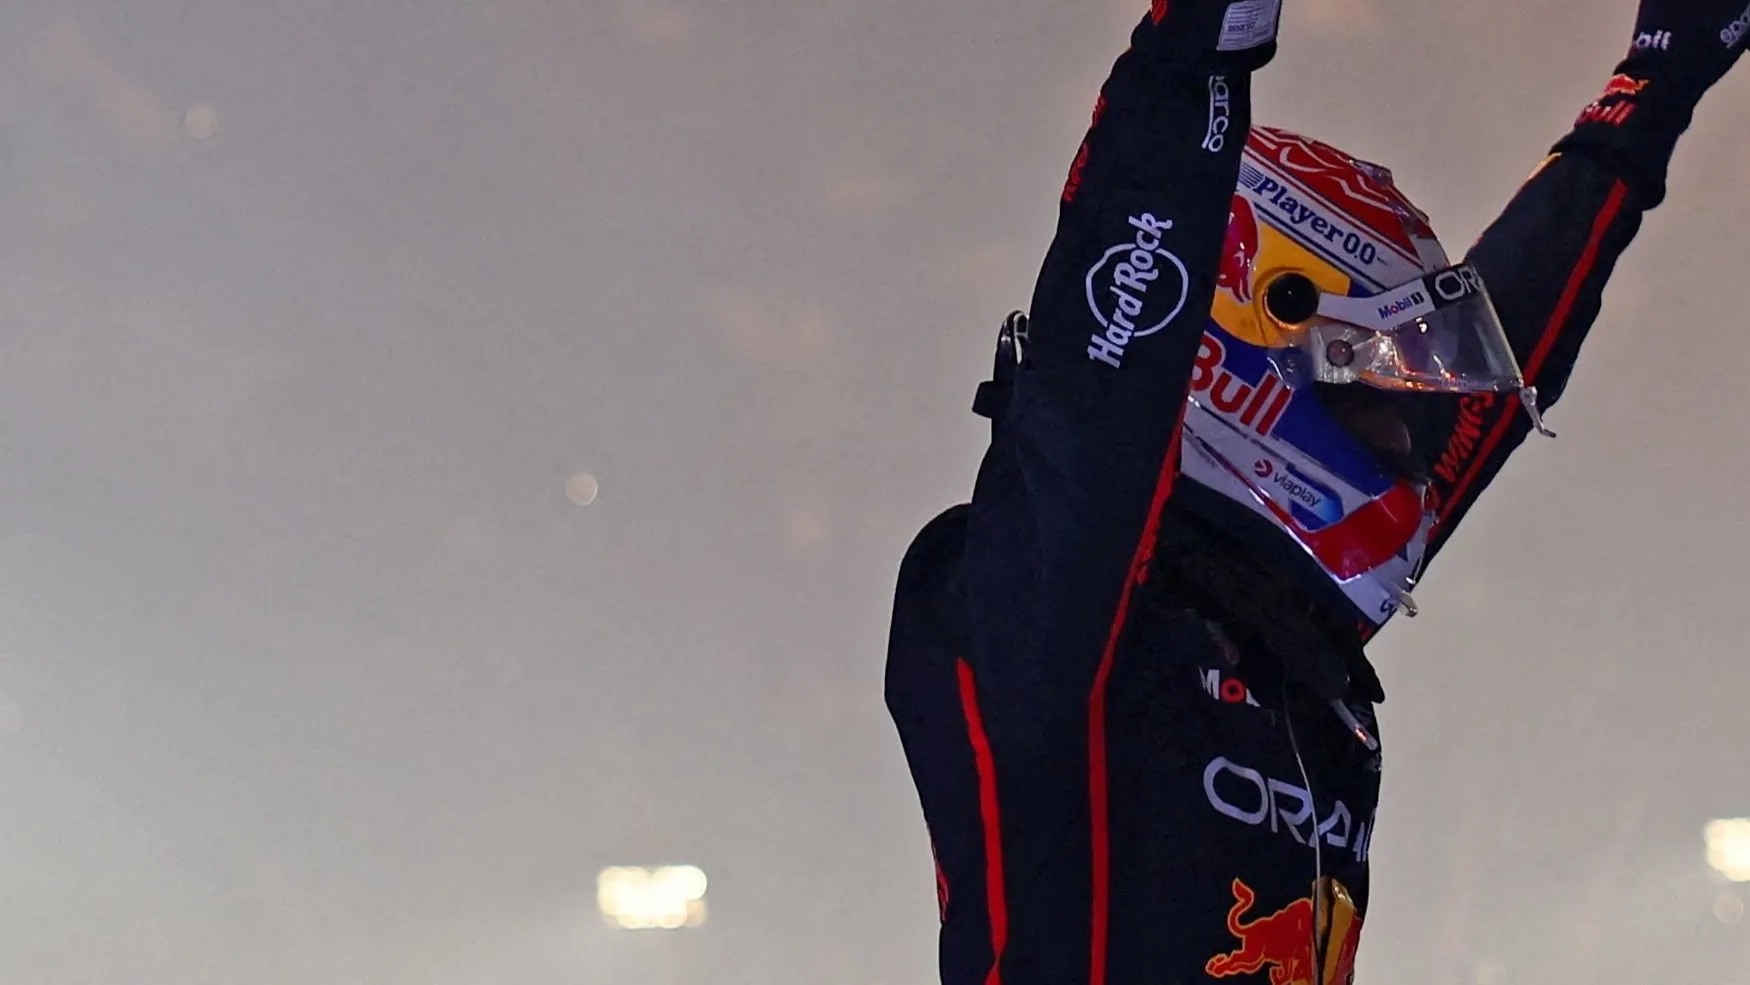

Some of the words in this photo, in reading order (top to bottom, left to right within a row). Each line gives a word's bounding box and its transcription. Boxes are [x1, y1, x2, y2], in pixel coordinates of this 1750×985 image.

[1206, 75, 1231, 154] arco
[1253, 176, 1344, 242] Player
[1114, 212, 1173, 293] Rock
[1087, 285, 1143, 369] Hard
[1378, 296, 1413, 319] Mobil
[1190, 335, 1292, 437] Bull
[1273, 471, 1322, 508] viaplay
